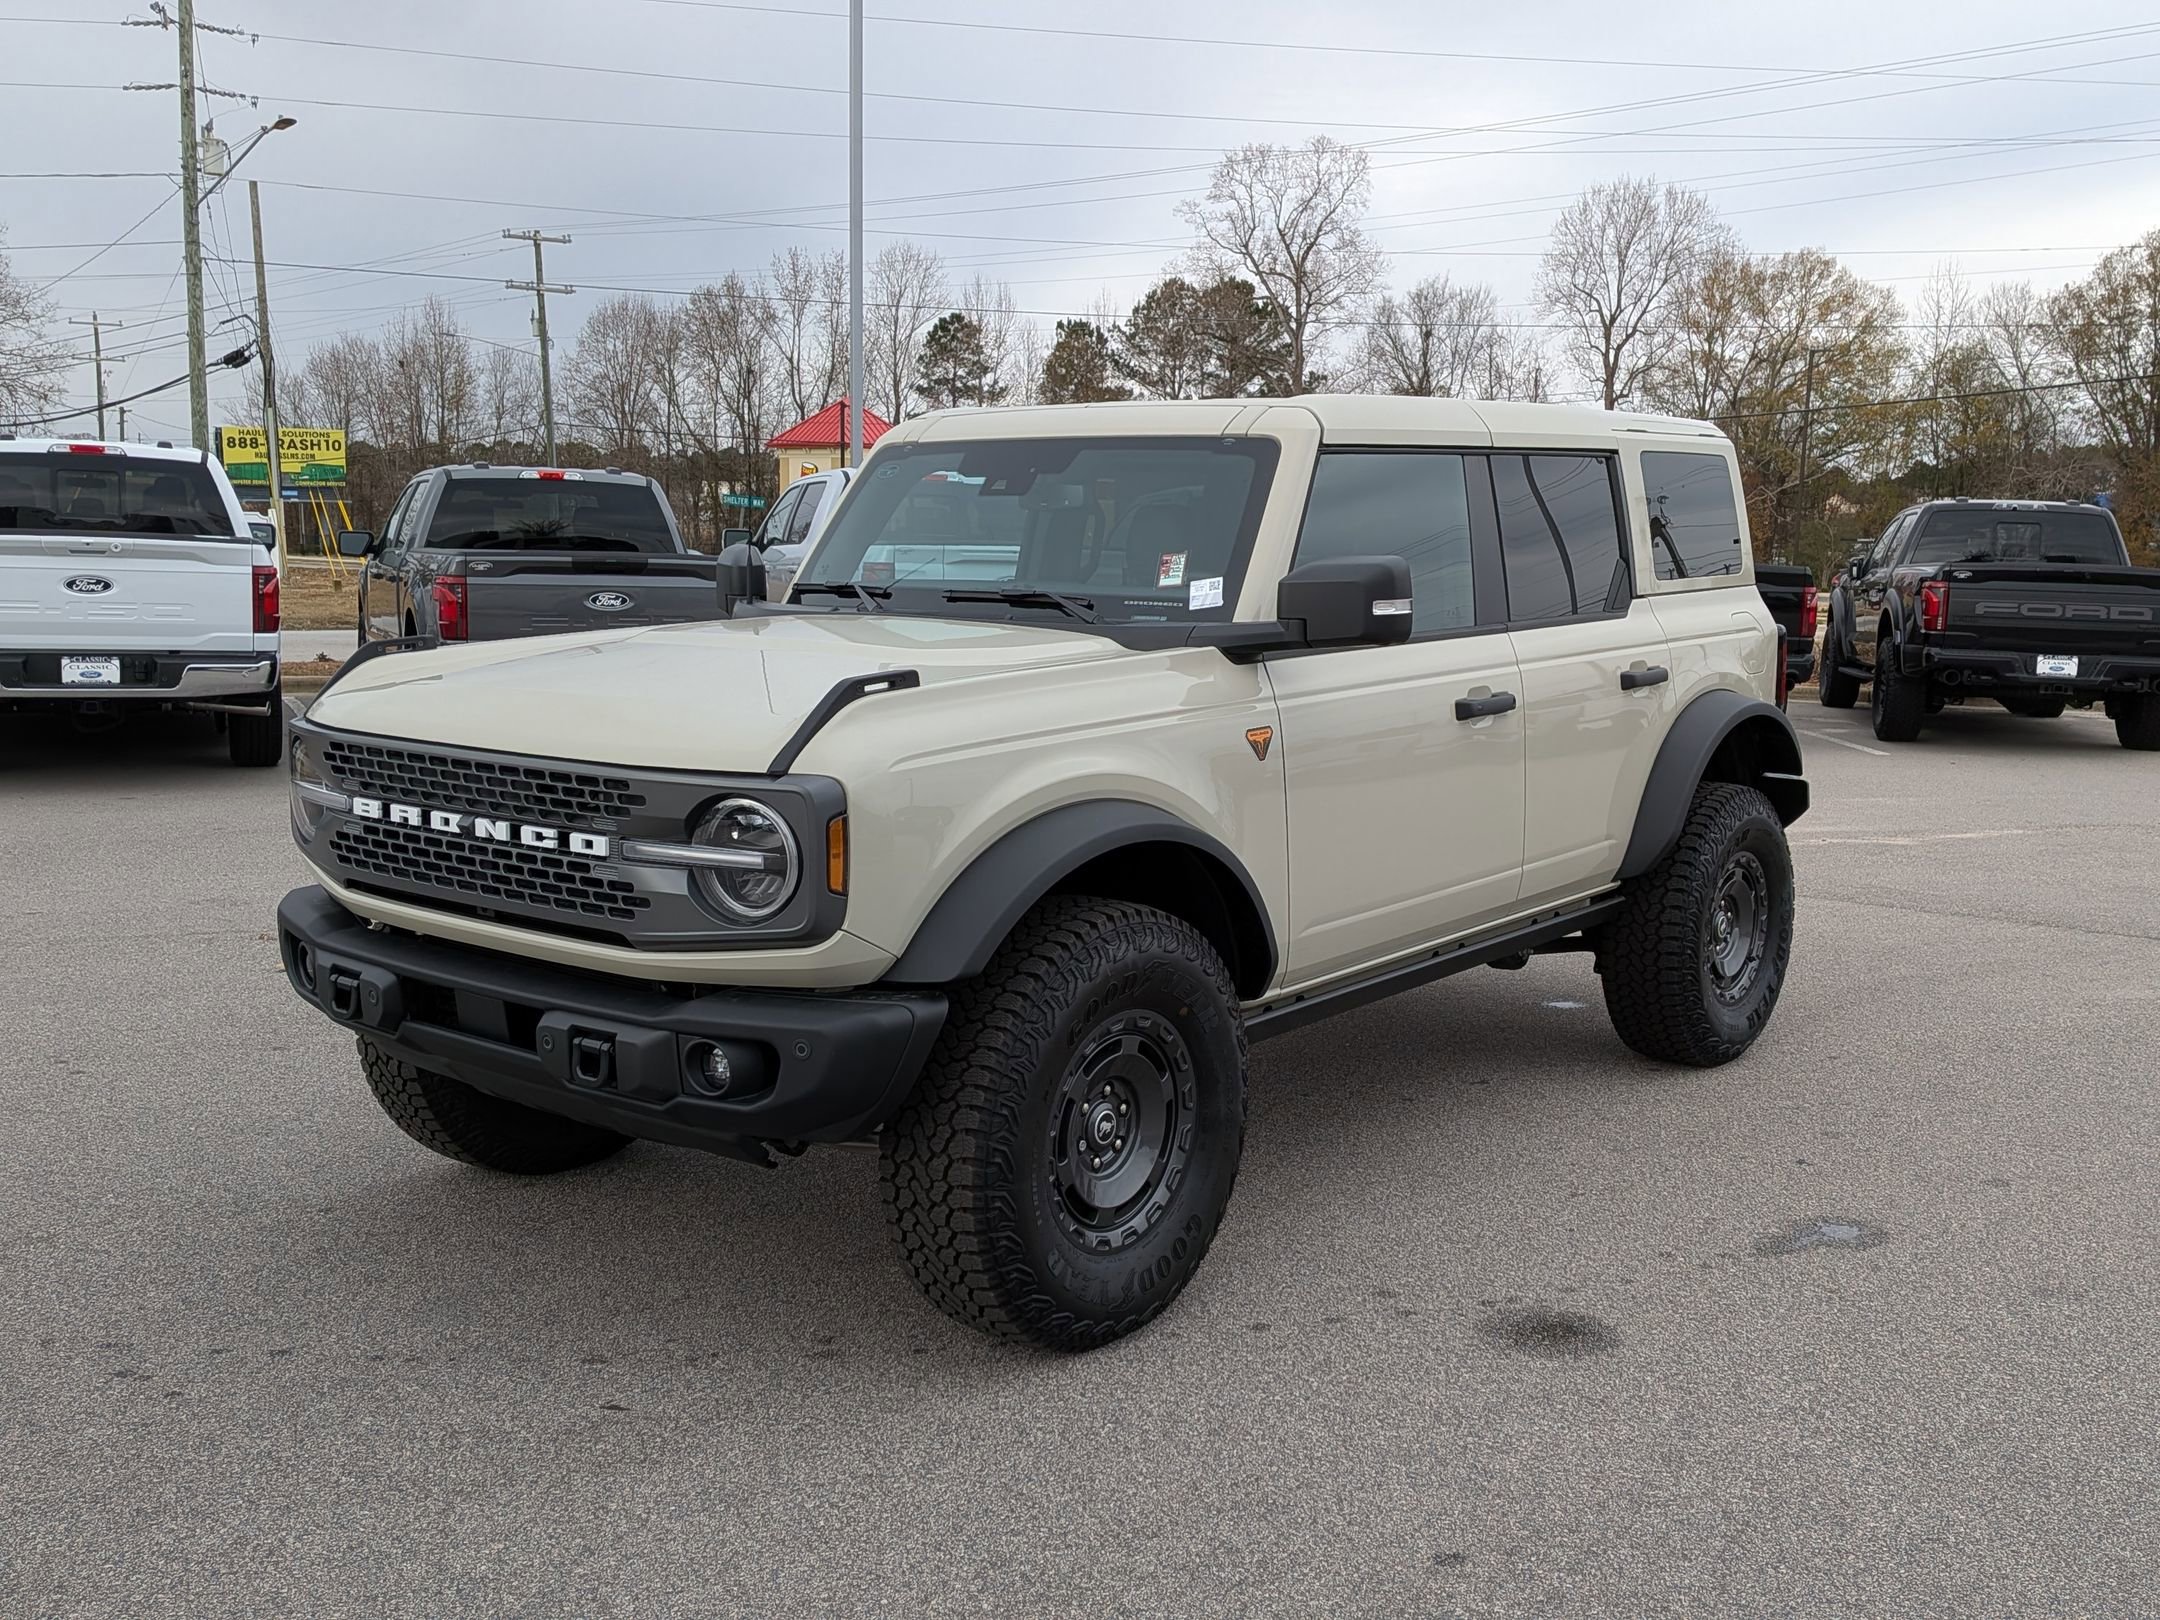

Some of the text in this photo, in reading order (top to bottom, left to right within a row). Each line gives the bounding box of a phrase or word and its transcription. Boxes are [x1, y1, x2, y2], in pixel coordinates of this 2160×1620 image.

[238, 429, 331, 439] HAULI SOLUTIONS
[226, 436, 341, 451] 888-RASH10
[723, 495, 765, 507] SHELTER WAY
[1975, 602, 2153, 621] FORD
[353, 797, 609, 857] BRONCO
[1067, 960, 1220, 1048] GOODYEAR
